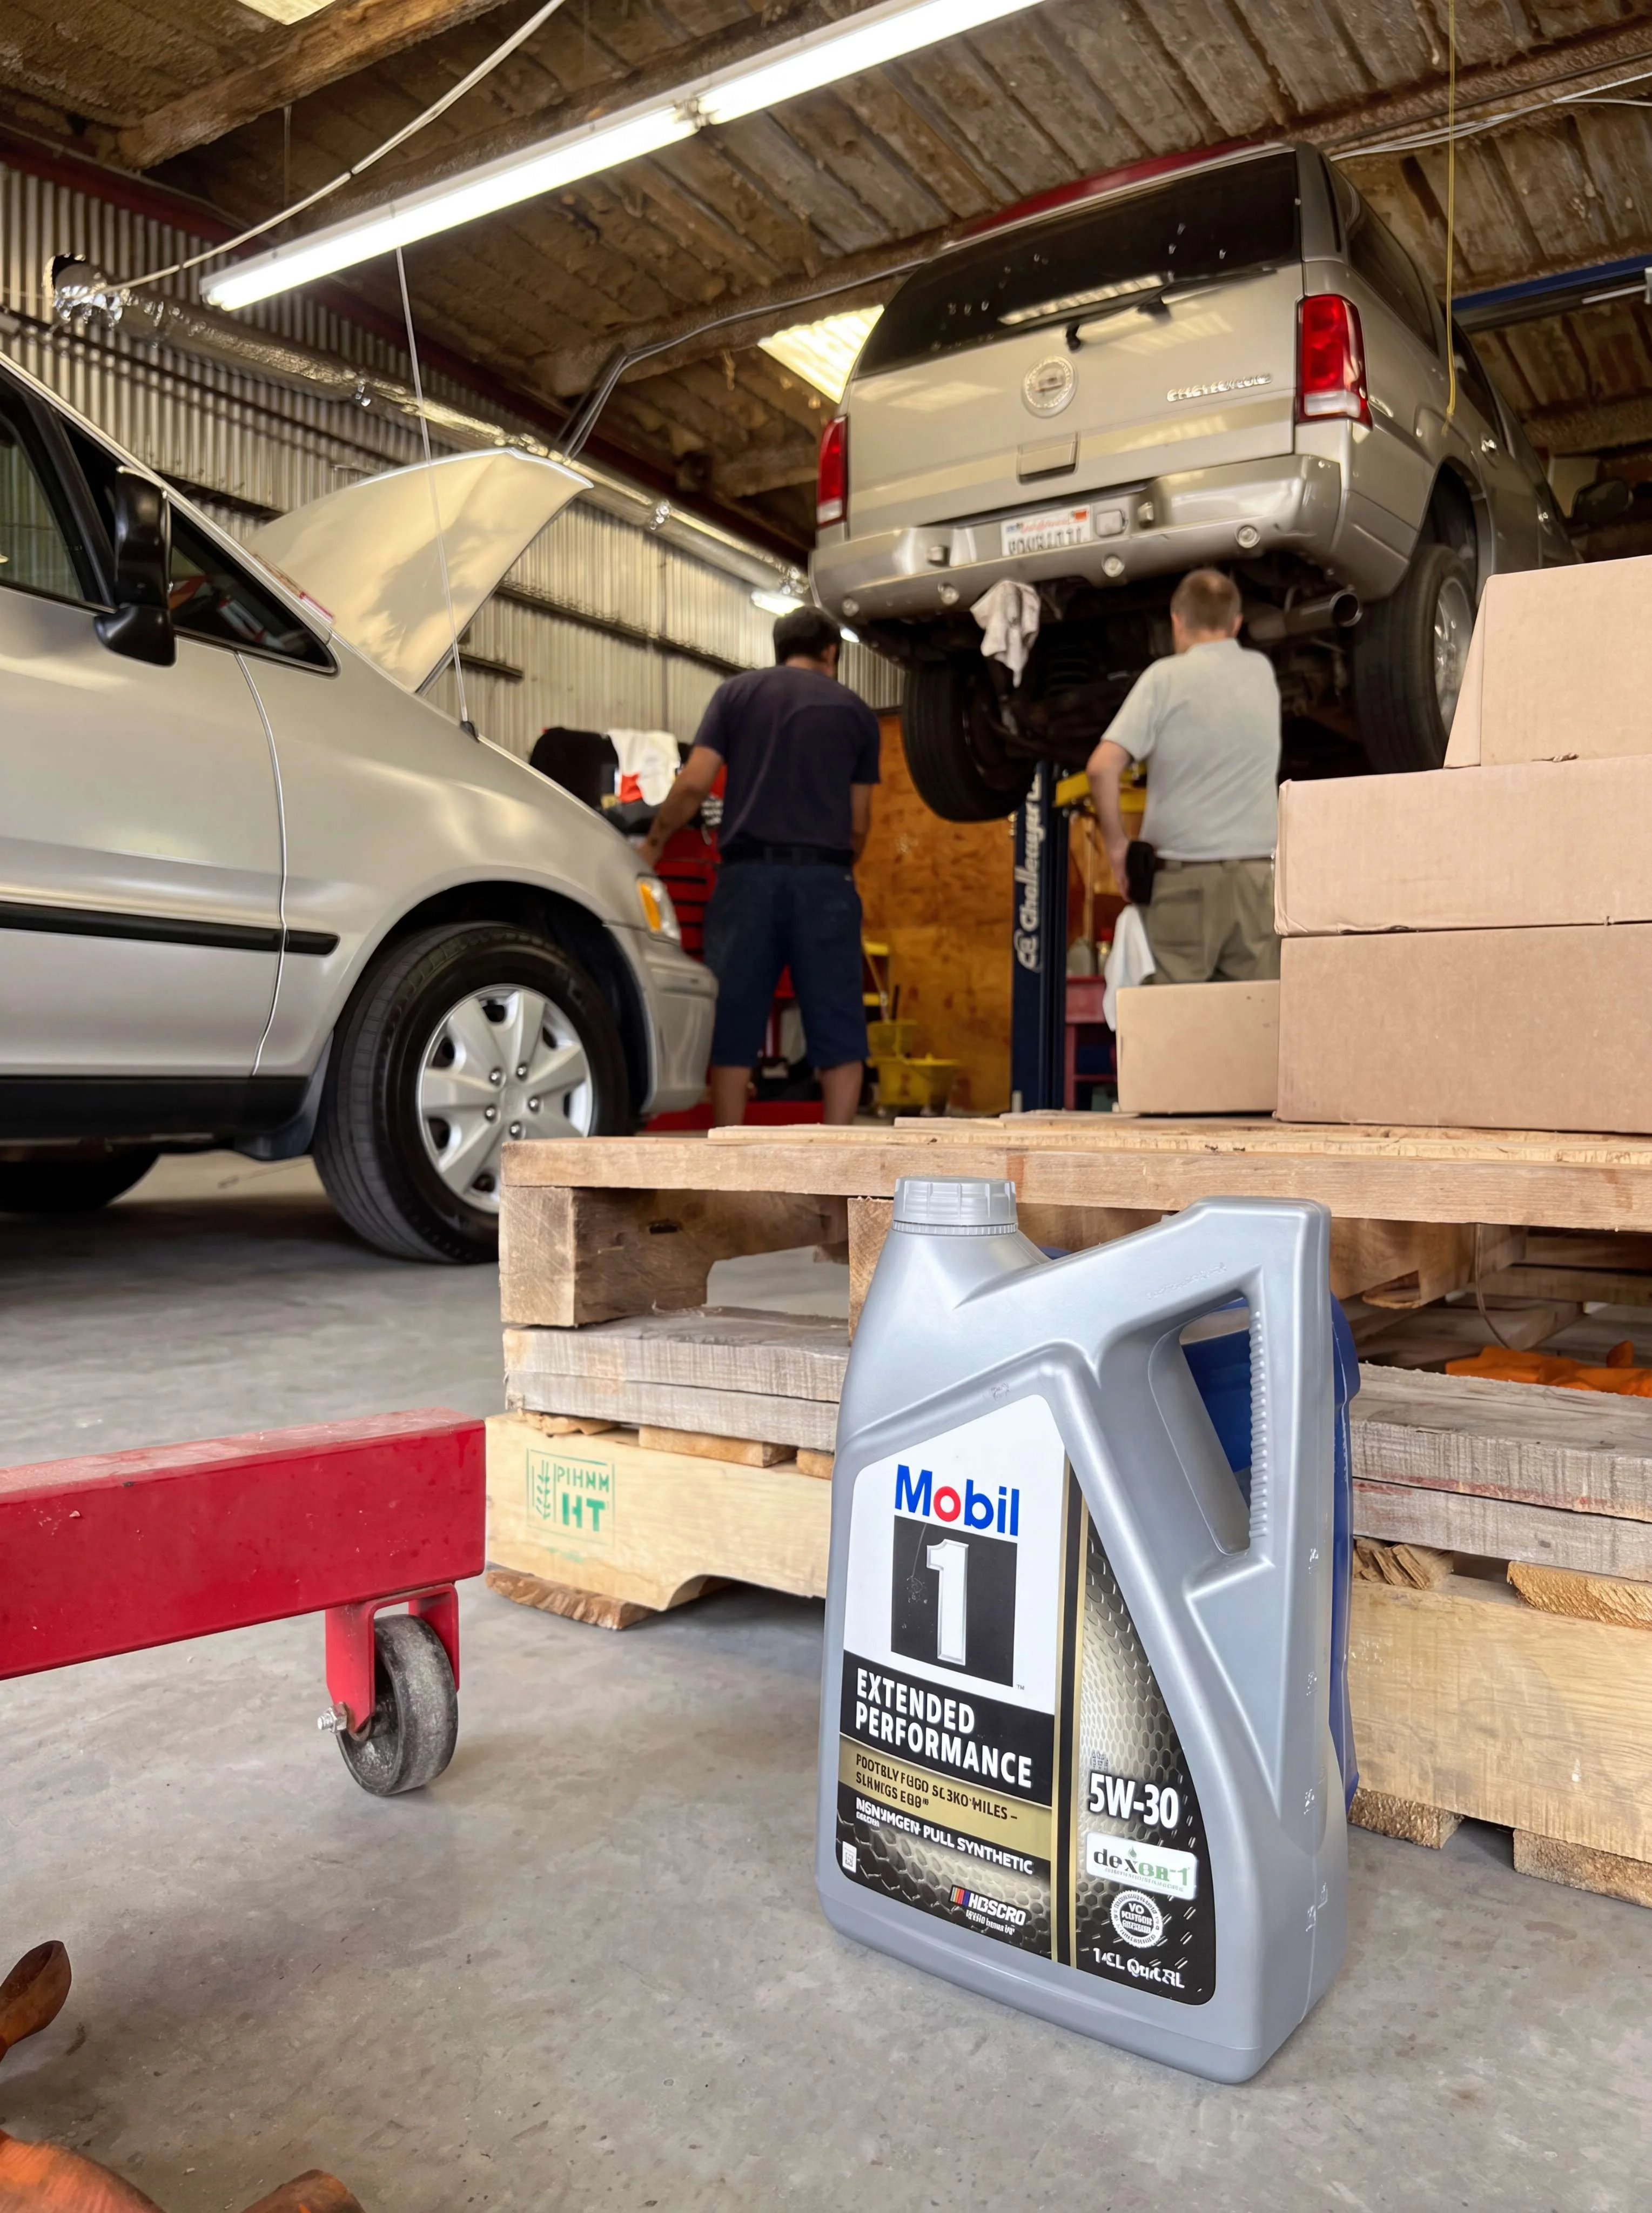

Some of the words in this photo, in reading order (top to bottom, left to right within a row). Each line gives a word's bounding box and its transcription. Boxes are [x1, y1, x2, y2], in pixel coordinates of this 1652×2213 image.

[562, 1492, 606, 1532] HT
[895, 1464, 1020, 1537] Mobil
[926, 1538, 969, 1666] 1
[857, 1667, 975, 1734] EXTENDED
[856, 1700, 1032, 1788] PERFORMANCE
[1089, 1772, 1180, 1829] 5W-30
[957, 1837, 1033, 1875] SYNTHETIC
